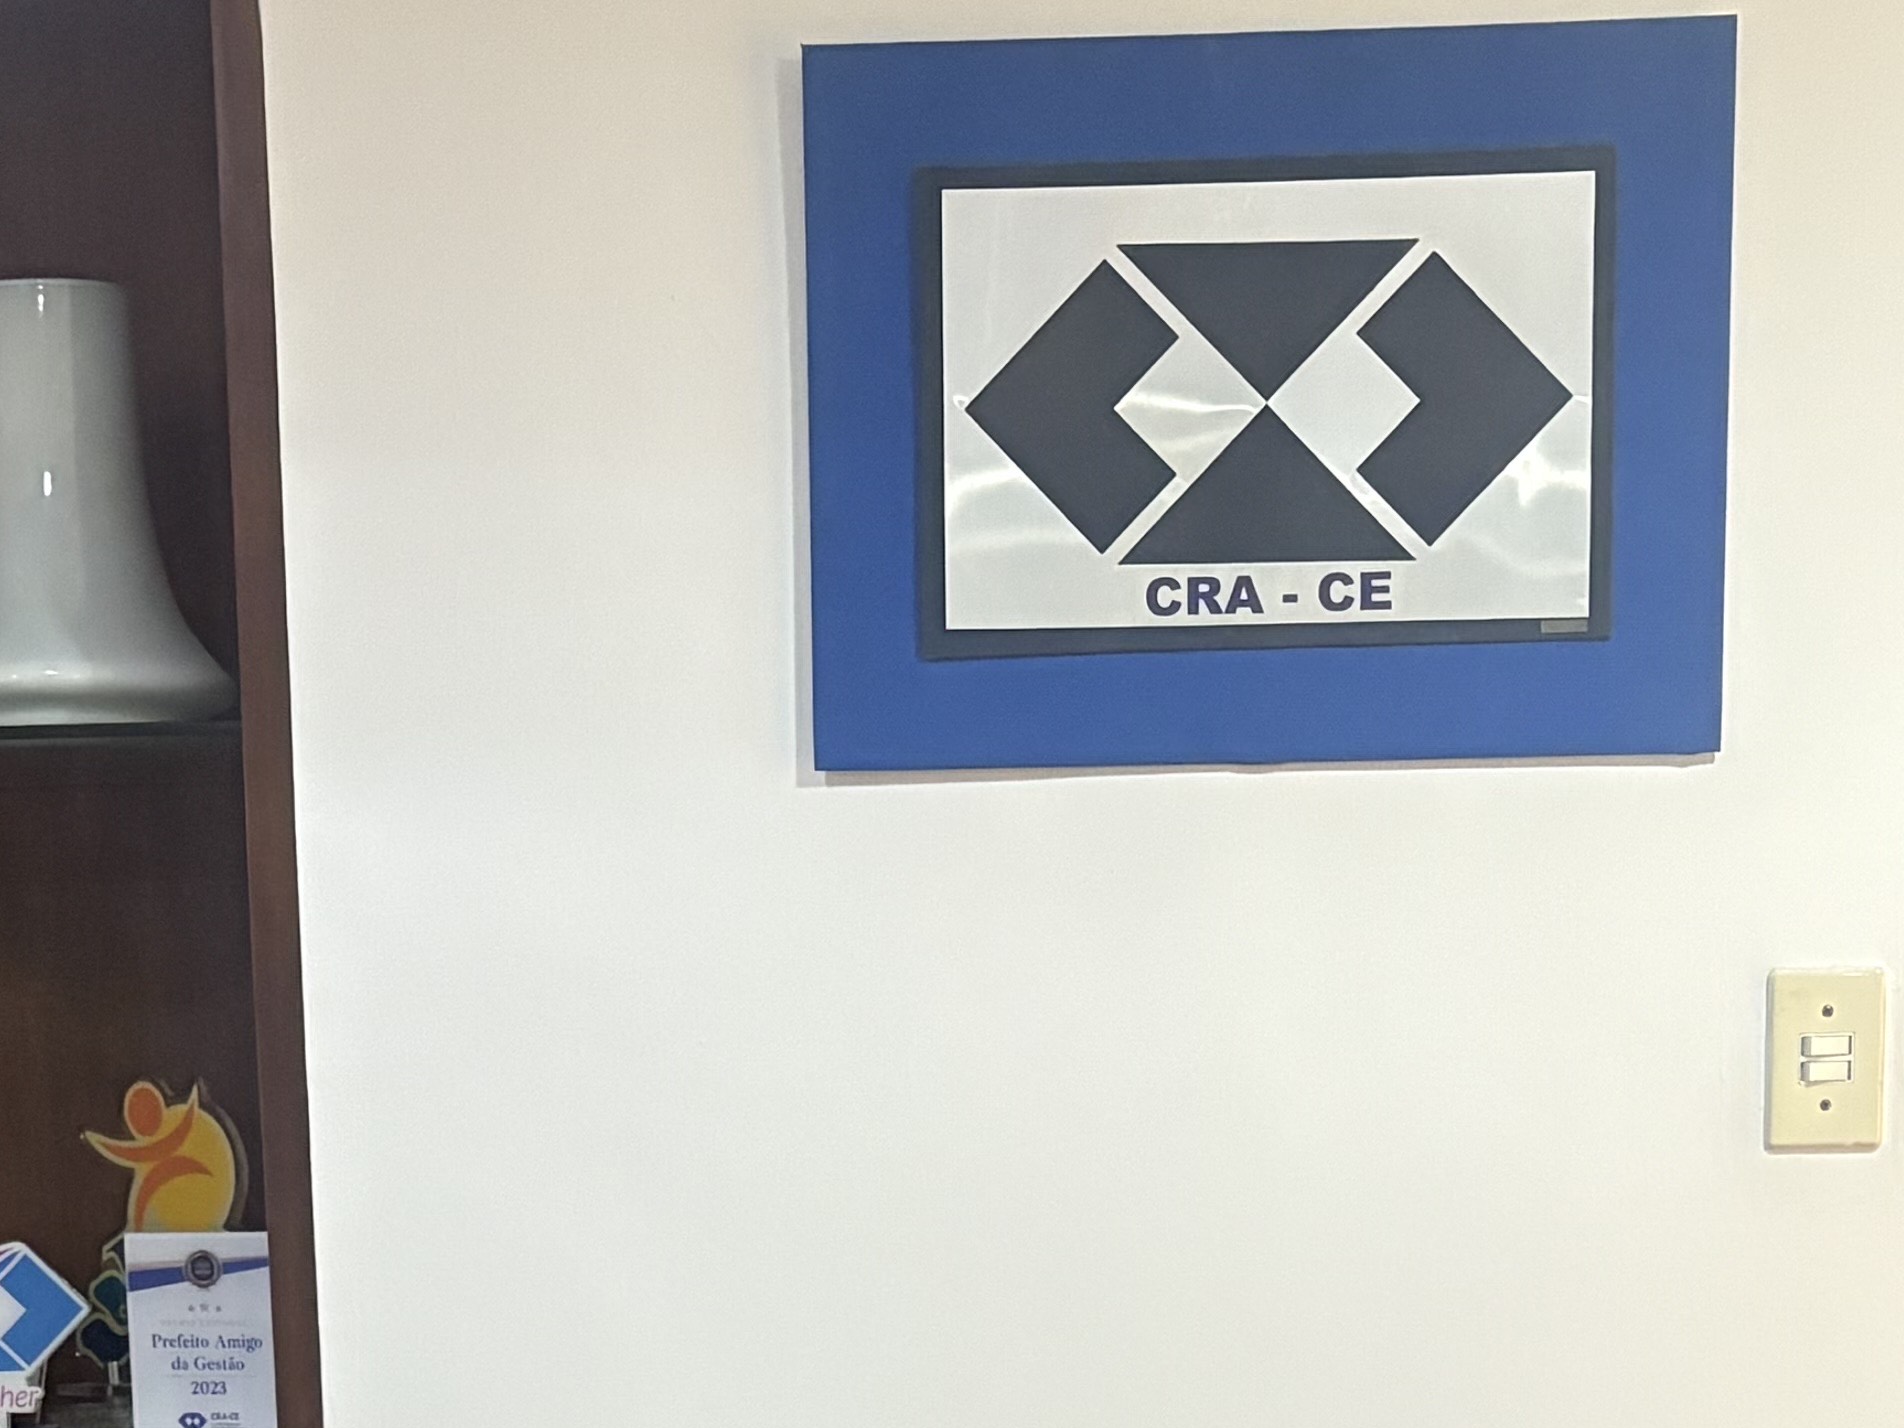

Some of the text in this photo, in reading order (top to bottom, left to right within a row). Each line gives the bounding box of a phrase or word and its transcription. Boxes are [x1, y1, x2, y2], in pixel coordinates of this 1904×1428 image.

[1146, 575, 1264, 617] CRA
[1318, 571, 1393, 612] CE
[151, 1333, 263, 1352] Prefeito Amigo
[171, 1356, 245, 1371] da Gestão
[191, 1380, 227, 1396] 2023
